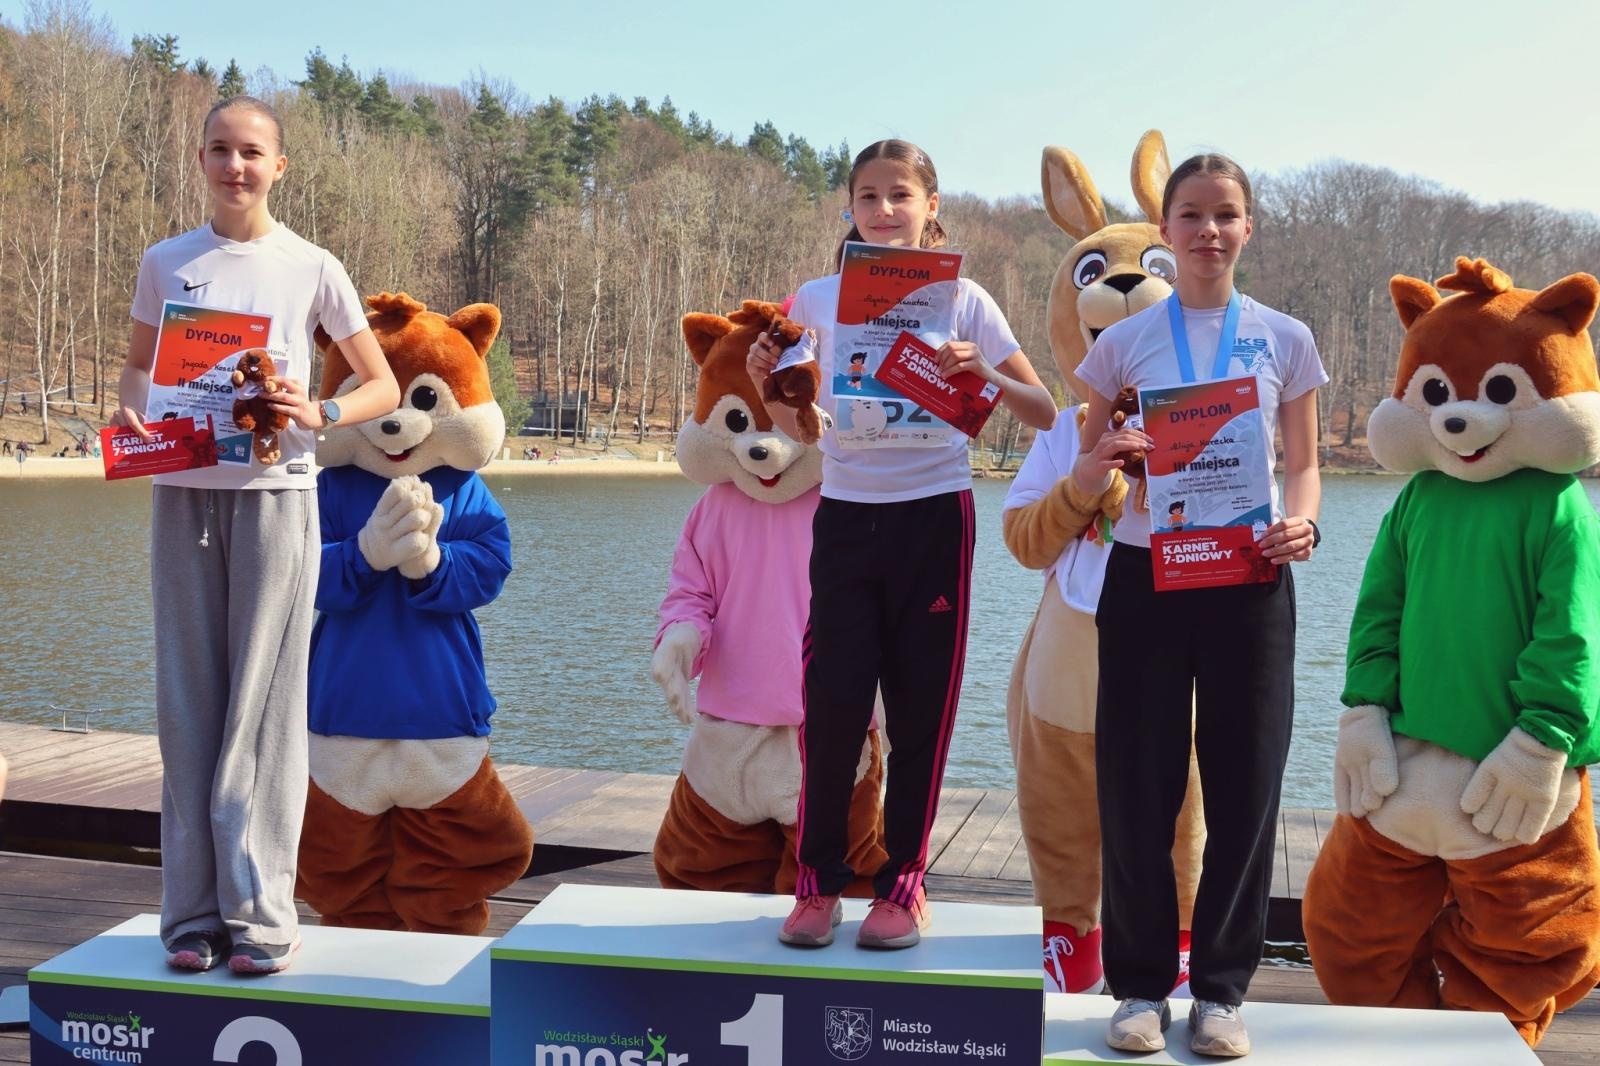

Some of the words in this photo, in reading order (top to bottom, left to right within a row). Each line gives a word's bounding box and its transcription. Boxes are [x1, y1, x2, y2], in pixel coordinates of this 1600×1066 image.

[869, 265, 931, 280] DYPLOM
[872, 314, 920, 330] miejsca
[185, 328, 242, 347] DYPLOM
[897, 355, 958, 395] 7-DNIOWY
[177, 377, 186, 388] II
[188, 378, 233, 394] miejsca
[1169, 403, 1232, 423] DYPLOM
[112, 433, 164, 448] KARET
[113, 440, 177, 457] 7-DNIOWY
[1173, 460, 1187, 473] III
[1189, 456, 1240, 471] miejsca
[1162, 541, 1219, 555] KARNET
[1163, 549, 1233, 565] 7-DNIOWY
[62, 1020, 155, 1049] mosir
[883, 1019, 932, 1034] Miasto
[543, 1030, 607, 1045] Wodzisław
[610, 1032, 644, 1048] Śląski
[73, 1046, 142, 1064] centrum
[882, 1038, 960, 1055] Wodzisław
[963, 1039, 1007, 1060] Śląski
